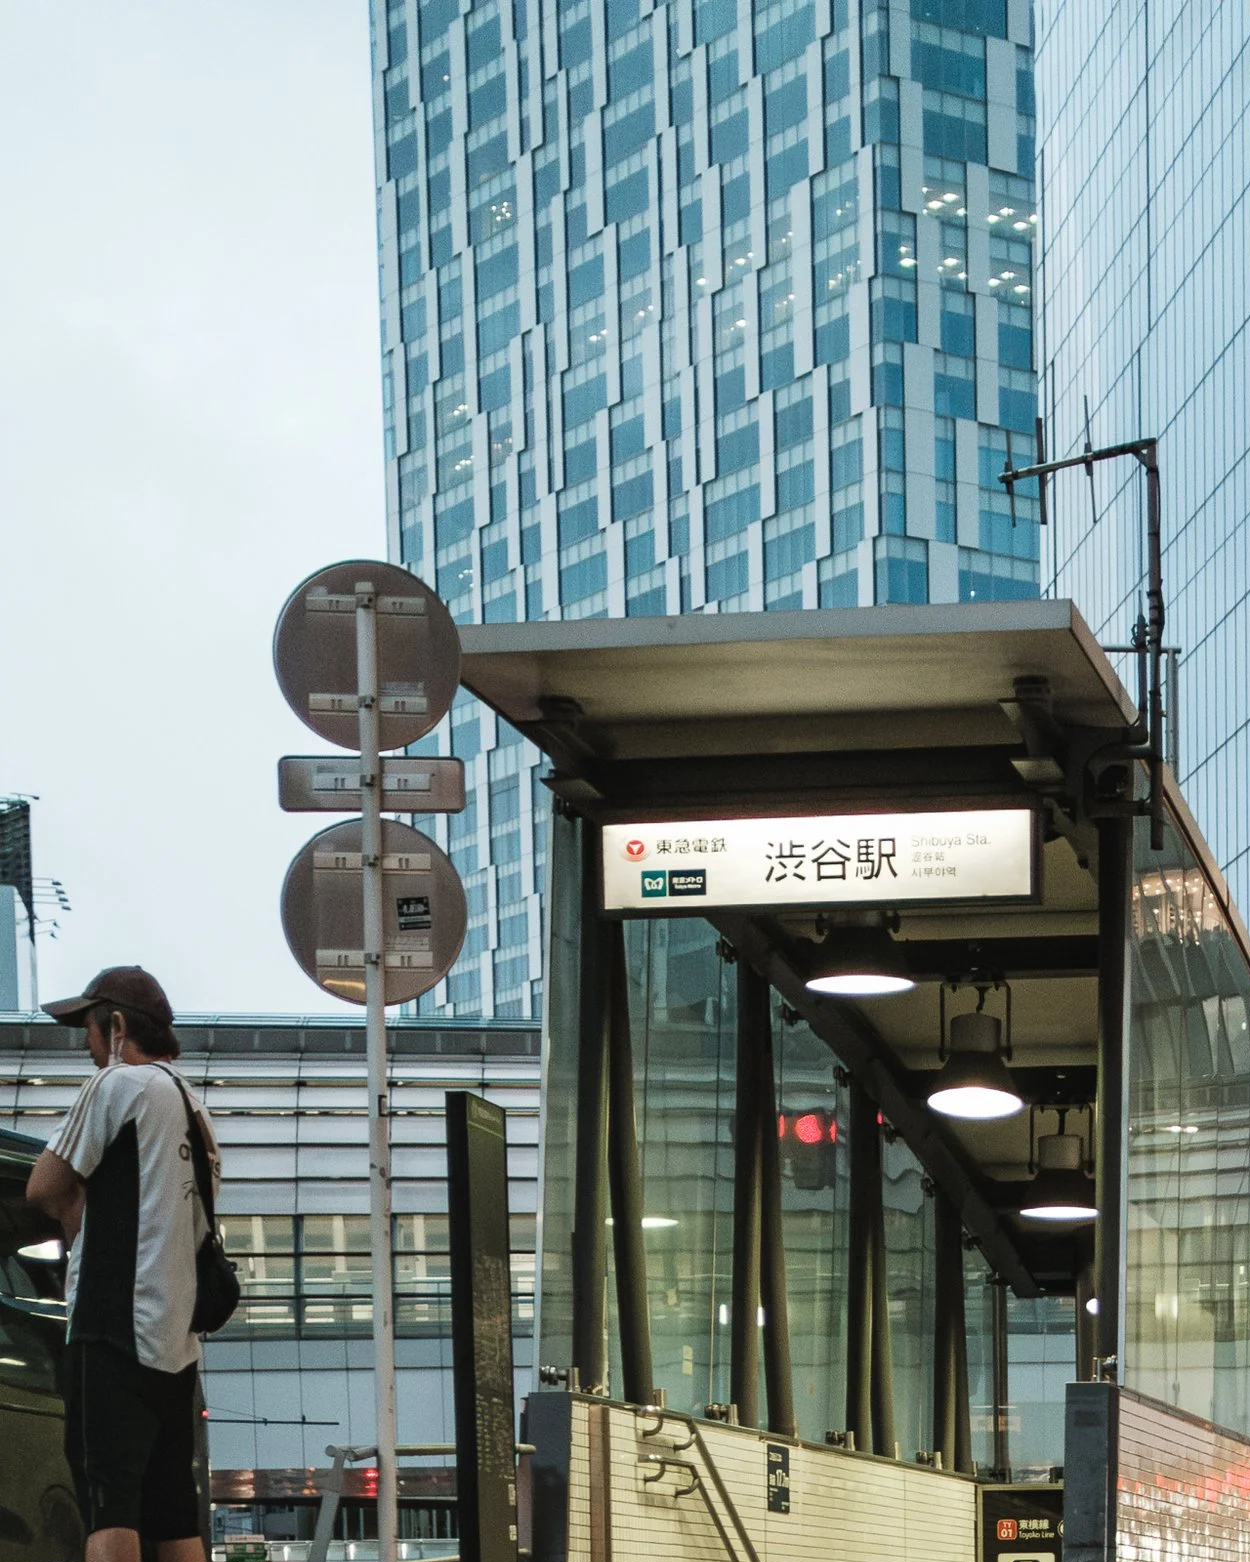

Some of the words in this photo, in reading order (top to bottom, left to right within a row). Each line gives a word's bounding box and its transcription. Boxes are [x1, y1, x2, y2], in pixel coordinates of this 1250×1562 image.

[656, 837, 727, 855] 東急電鉄
[911, 833, 962, 849] Shibuya
[966, 831, 991, 846] Sta.
[765, 838, 898, 882] 渋谷駅
[1001, 1529, 1013, 1538] 01
